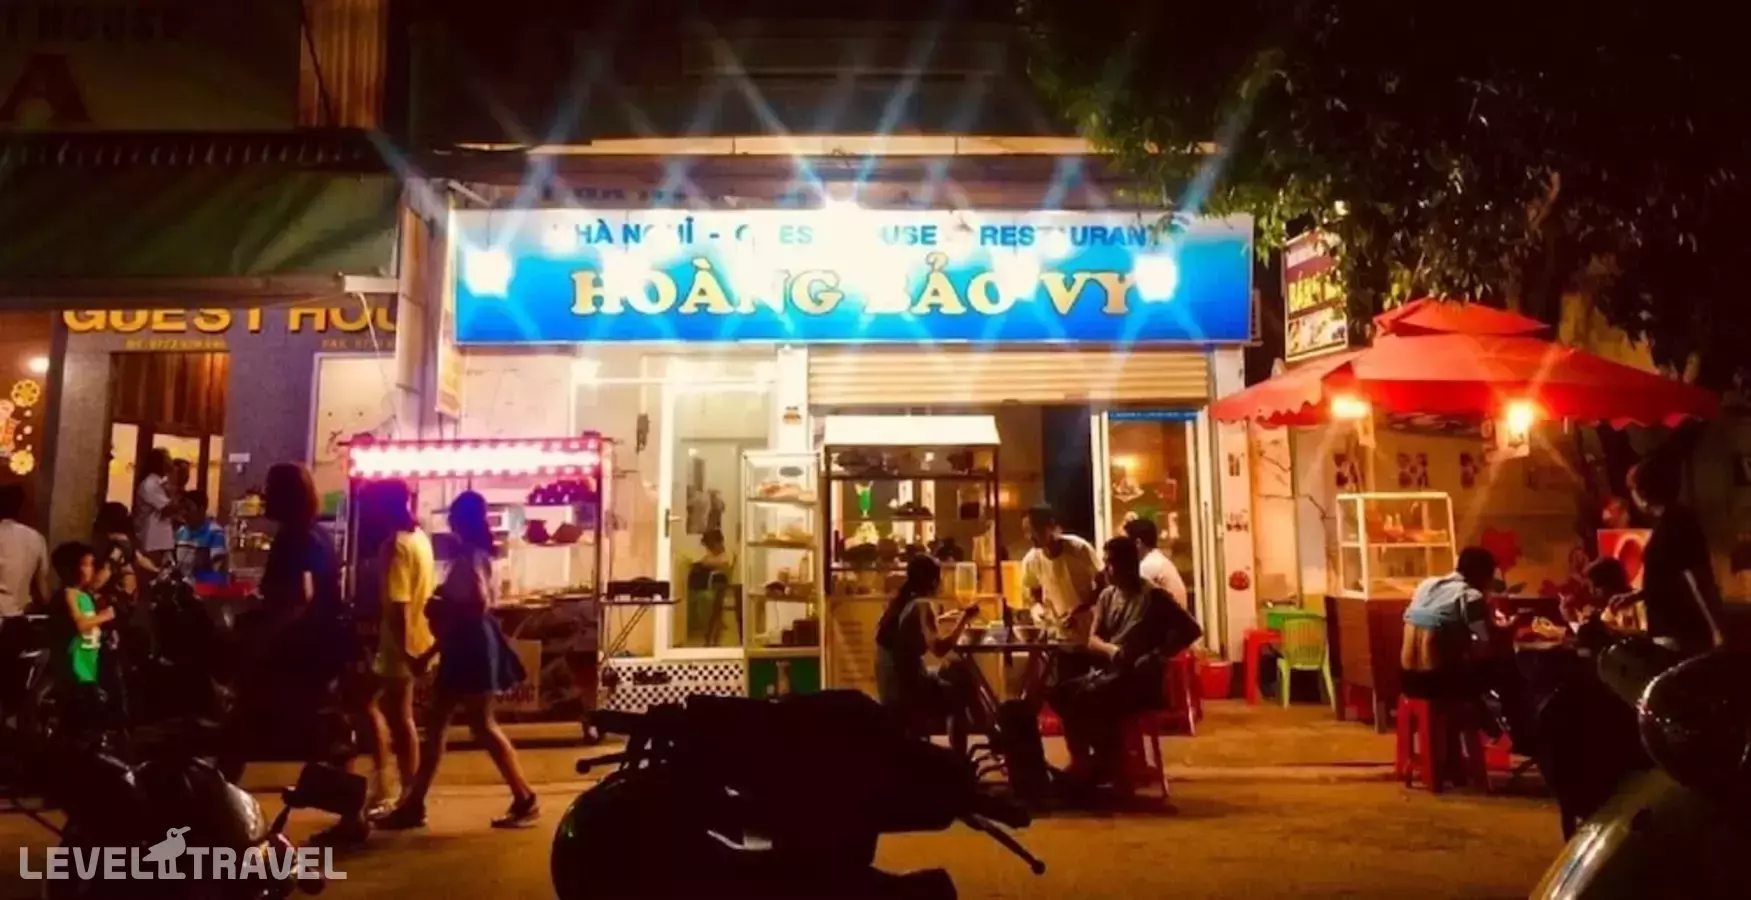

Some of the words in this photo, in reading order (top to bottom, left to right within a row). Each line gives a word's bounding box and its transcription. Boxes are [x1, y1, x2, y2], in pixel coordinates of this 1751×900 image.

[557, 217, 614, 244] HÀ
[979, 225, 1163, 247] RESURAN
[570, 256, 845, 316] HOÀNG
[864, 251, 1018, 316] ẢO
[1039, 268, 1137, 316] VY
[62, 308, 261, 333] GUEST
